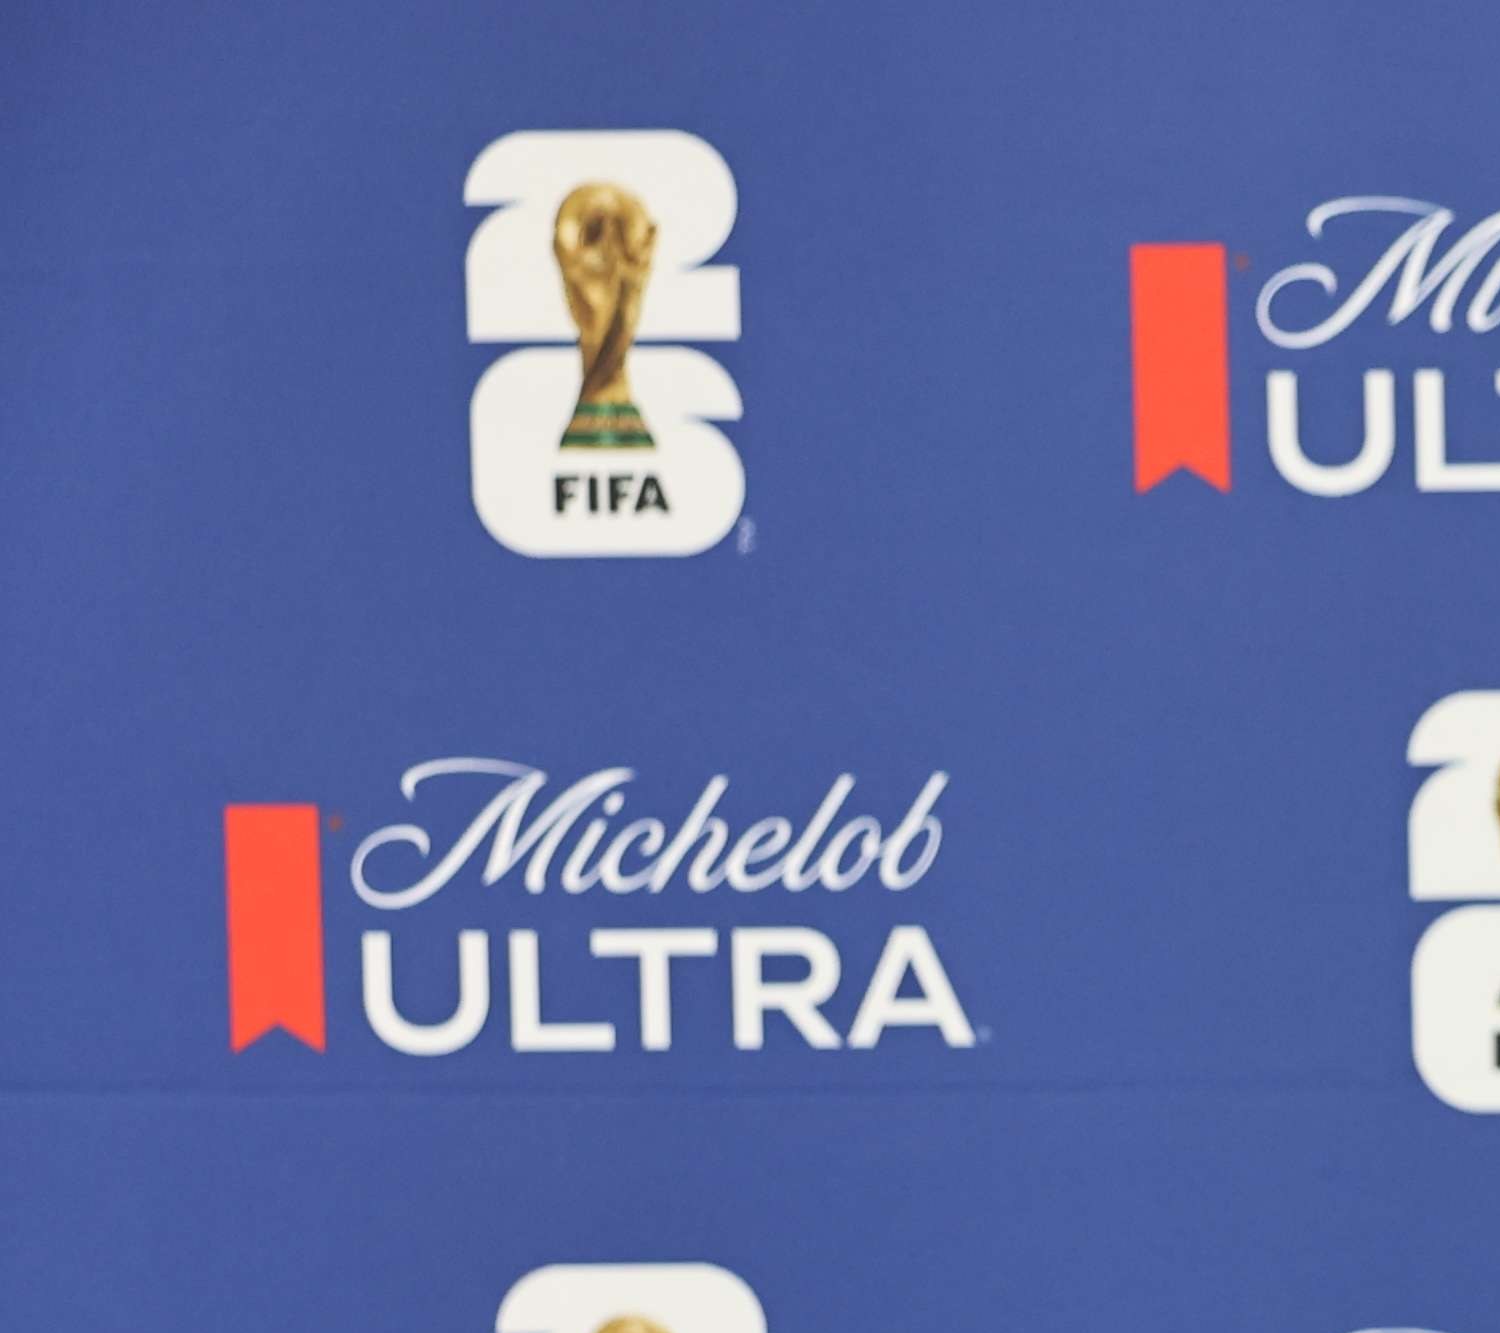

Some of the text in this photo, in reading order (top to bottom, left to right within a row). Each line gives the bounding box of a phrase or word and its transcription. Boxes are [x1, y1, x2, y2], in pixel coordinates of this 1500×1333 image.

[554, 475, 669, 514] FIFA
[352, 759, 946, 908] Michelob
[362, 927, 974, 1055] ULTRA
